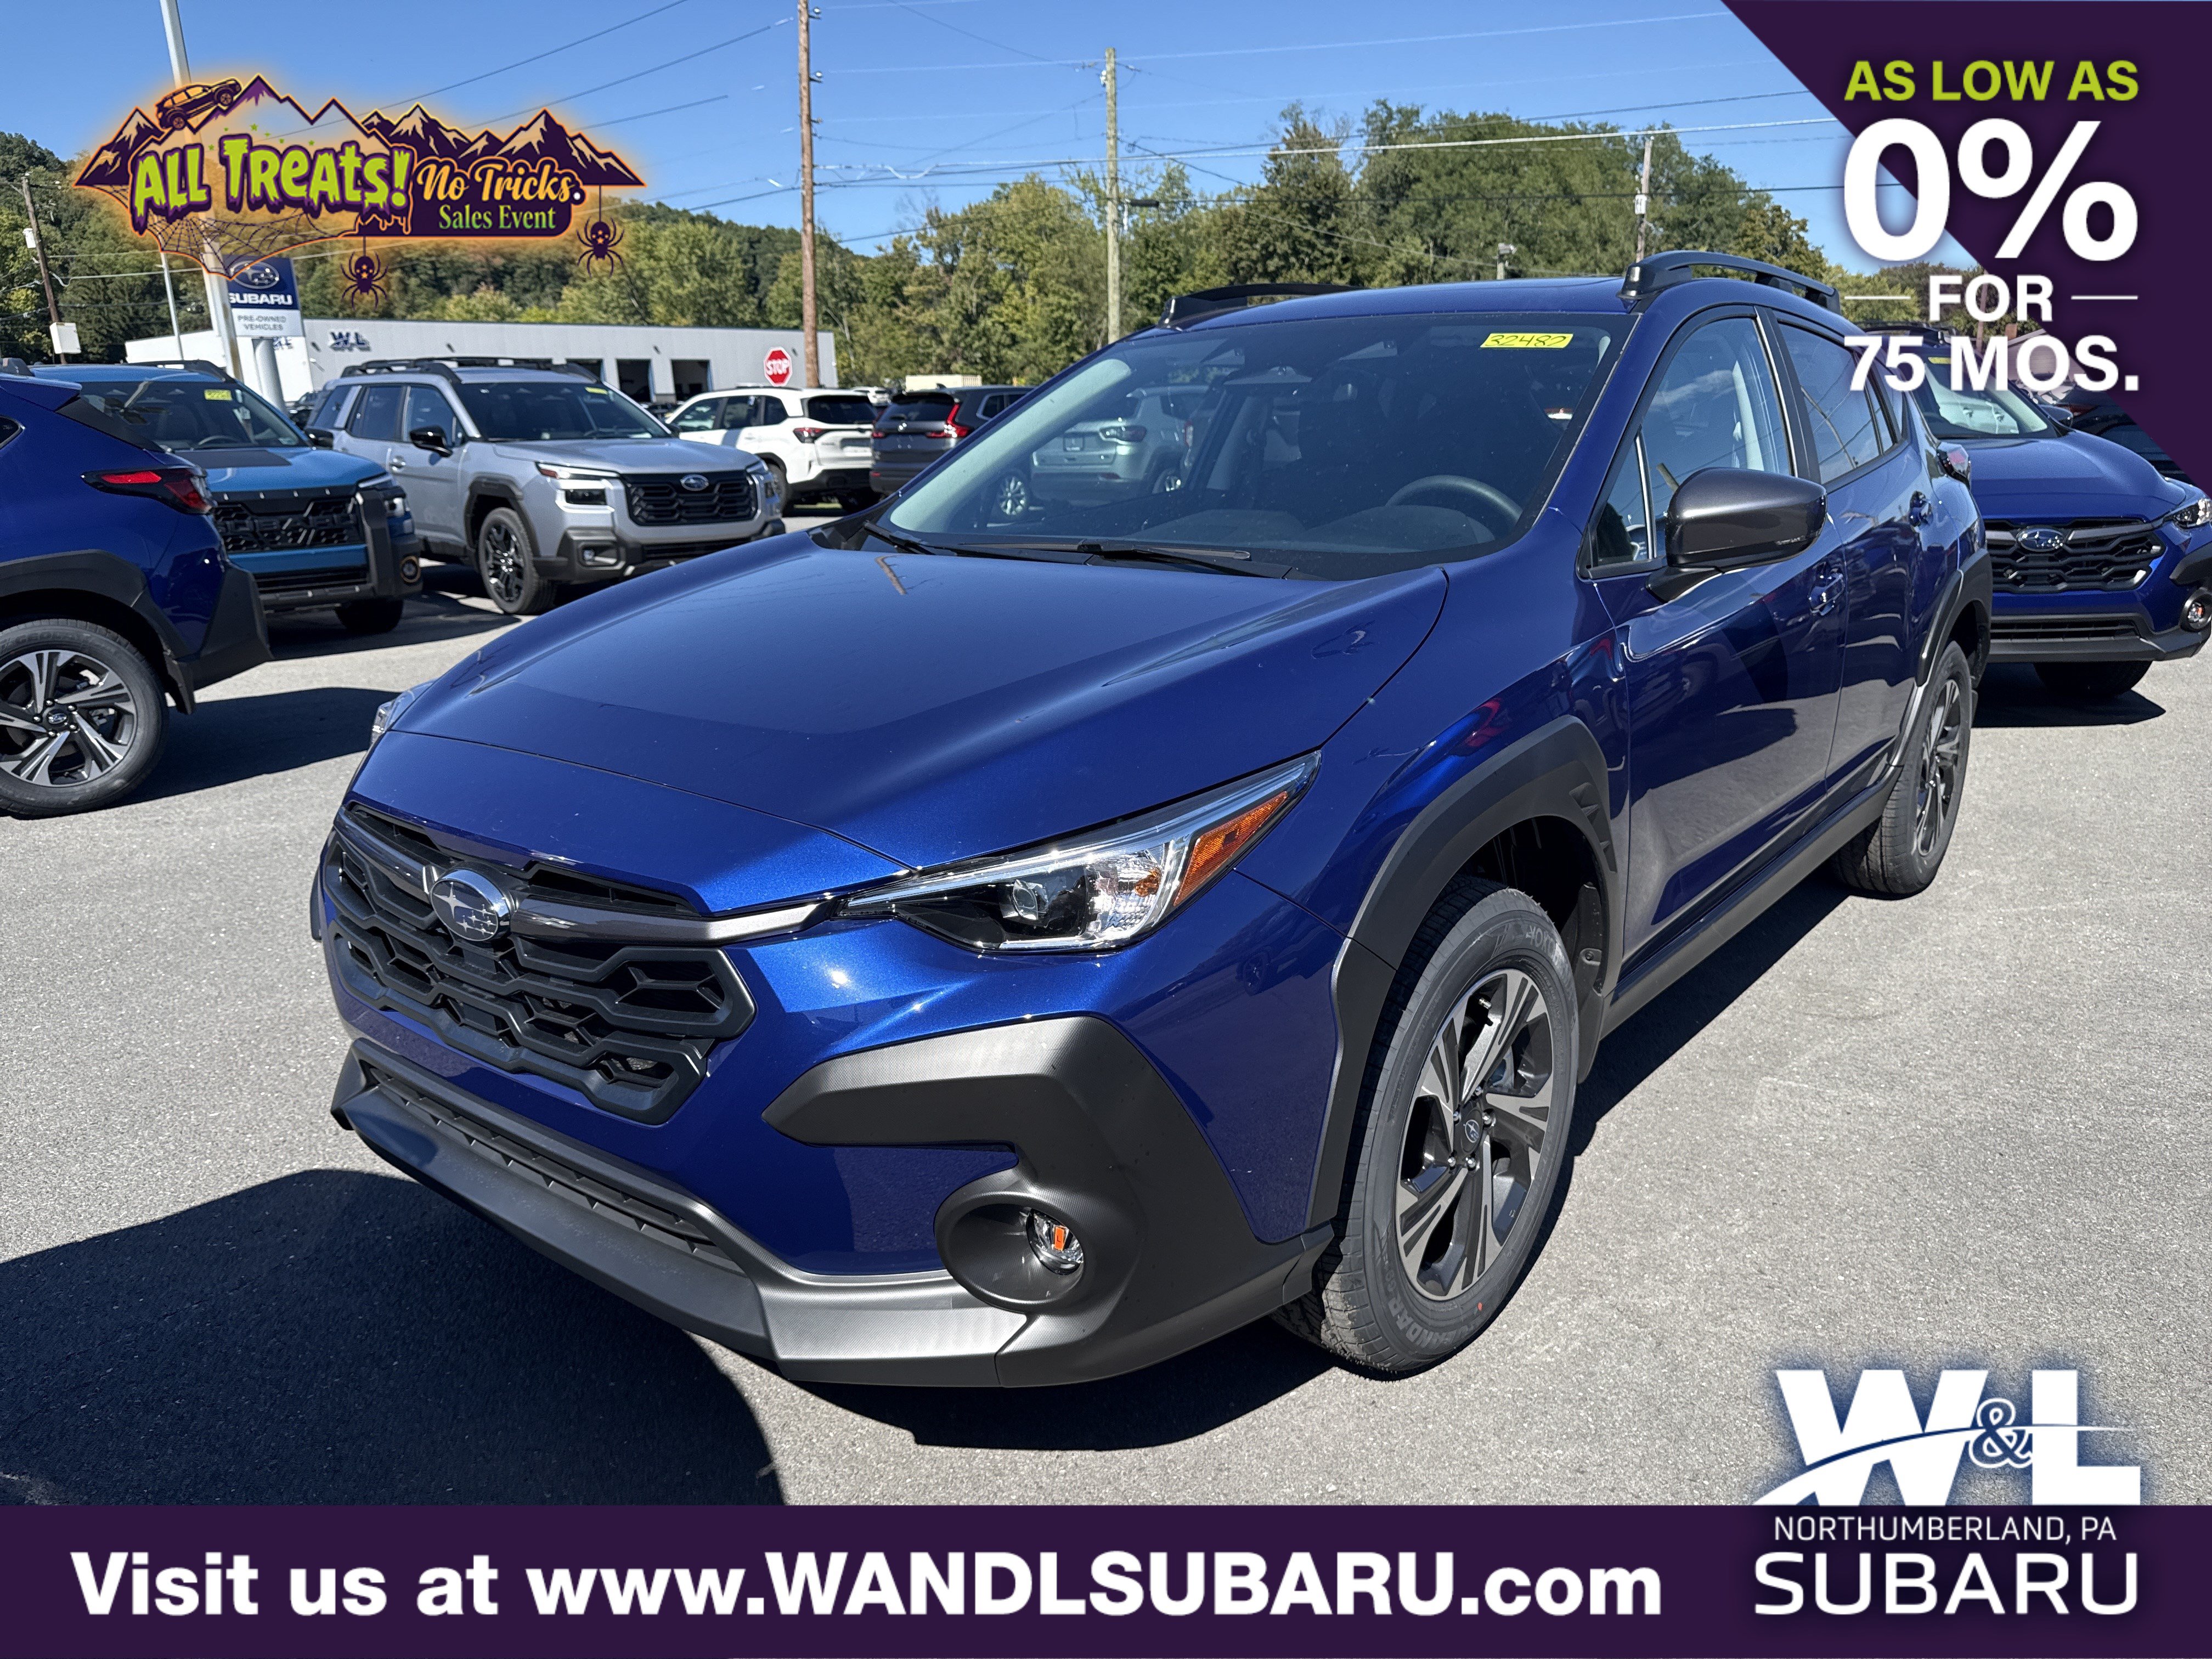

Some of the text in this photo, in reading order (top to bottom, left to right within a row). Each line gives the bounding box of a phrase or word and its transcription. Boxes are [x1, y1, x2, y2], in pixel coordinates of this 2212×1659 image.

[228, 292, 293, 306] SUBARU
[1485, 335, 1567, 347] 32482
[766, 358, 789, 376] STOP
